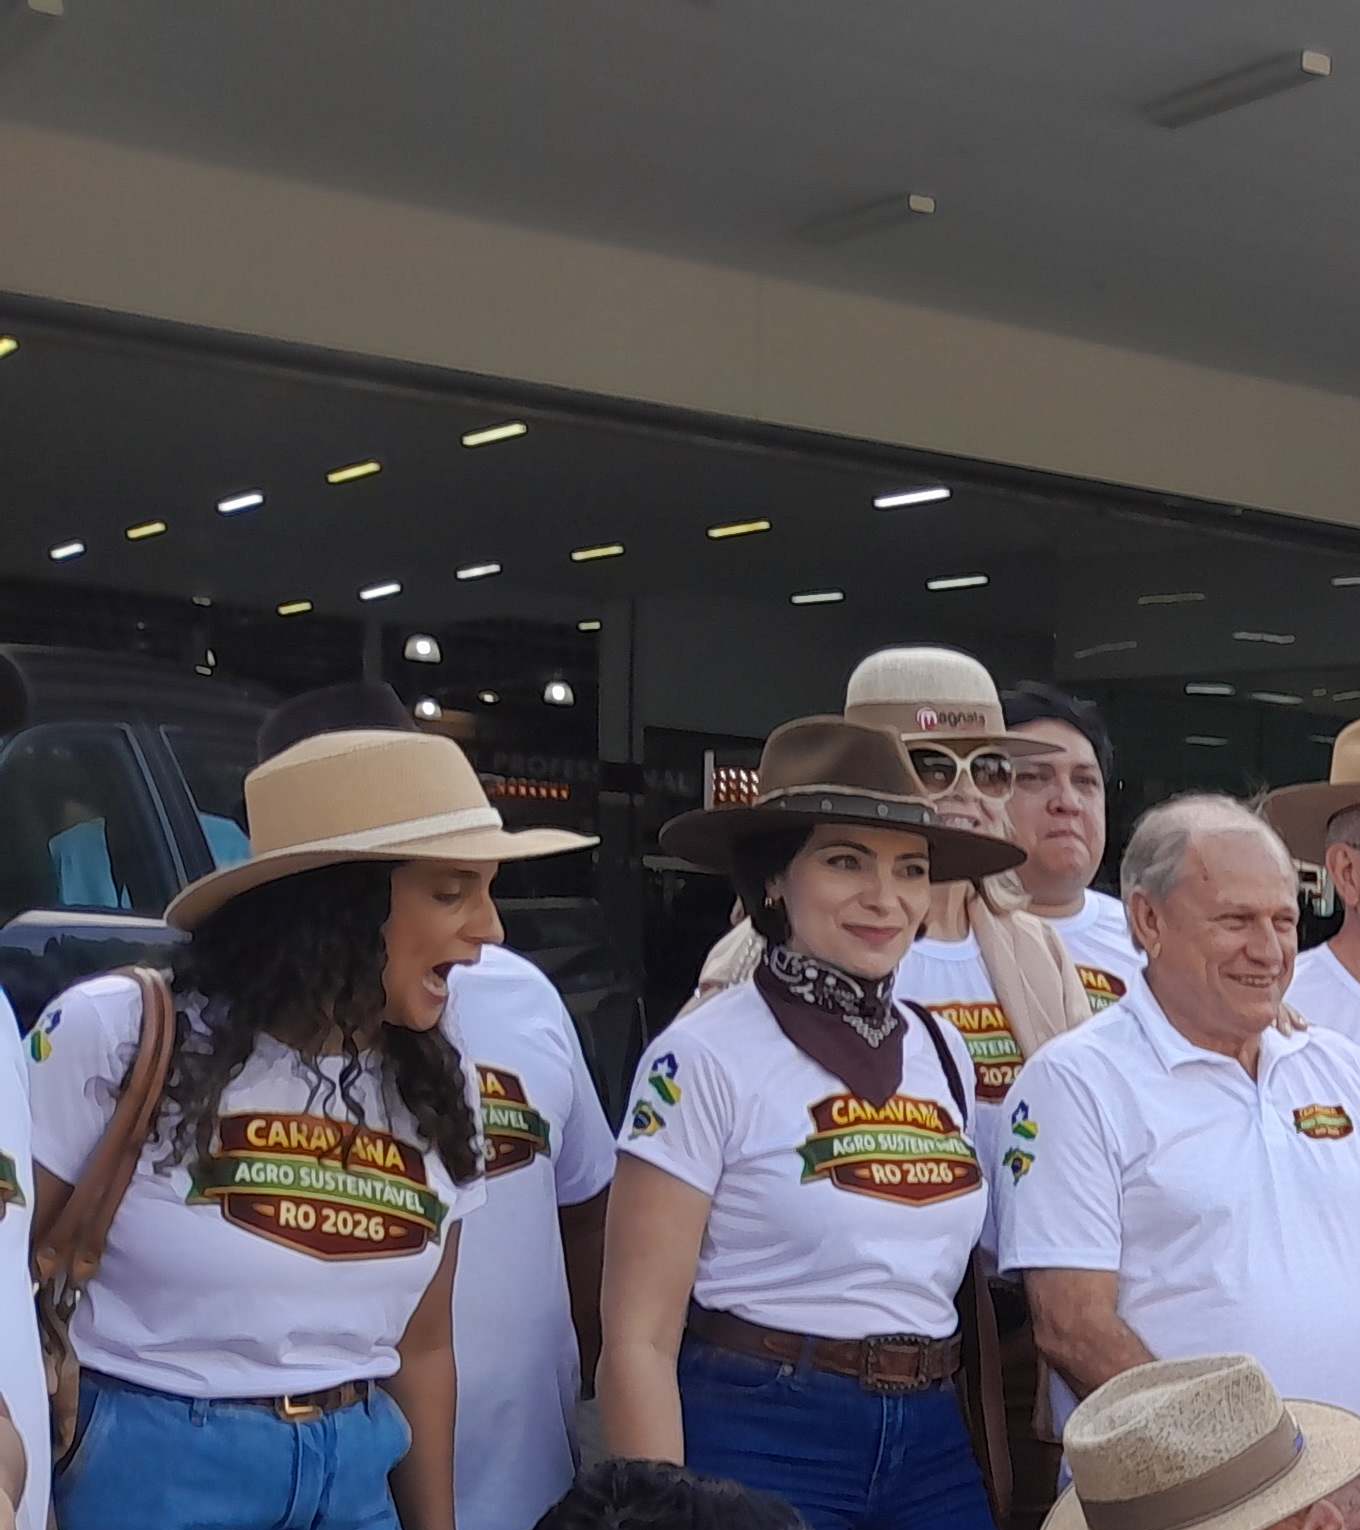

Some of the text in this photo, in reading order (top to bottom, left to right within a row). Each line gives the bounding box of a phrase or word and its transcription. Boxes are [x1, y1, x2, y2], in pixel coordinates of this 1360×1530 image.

[832, 1134, 877, 1158] AGRO
[234, 1162, 425, 1214] AGRO SUSTENTÁVEL
[870, 1162, 954, 1185] RO 2026
[279, 1200, 406, 1241] RO 2026
